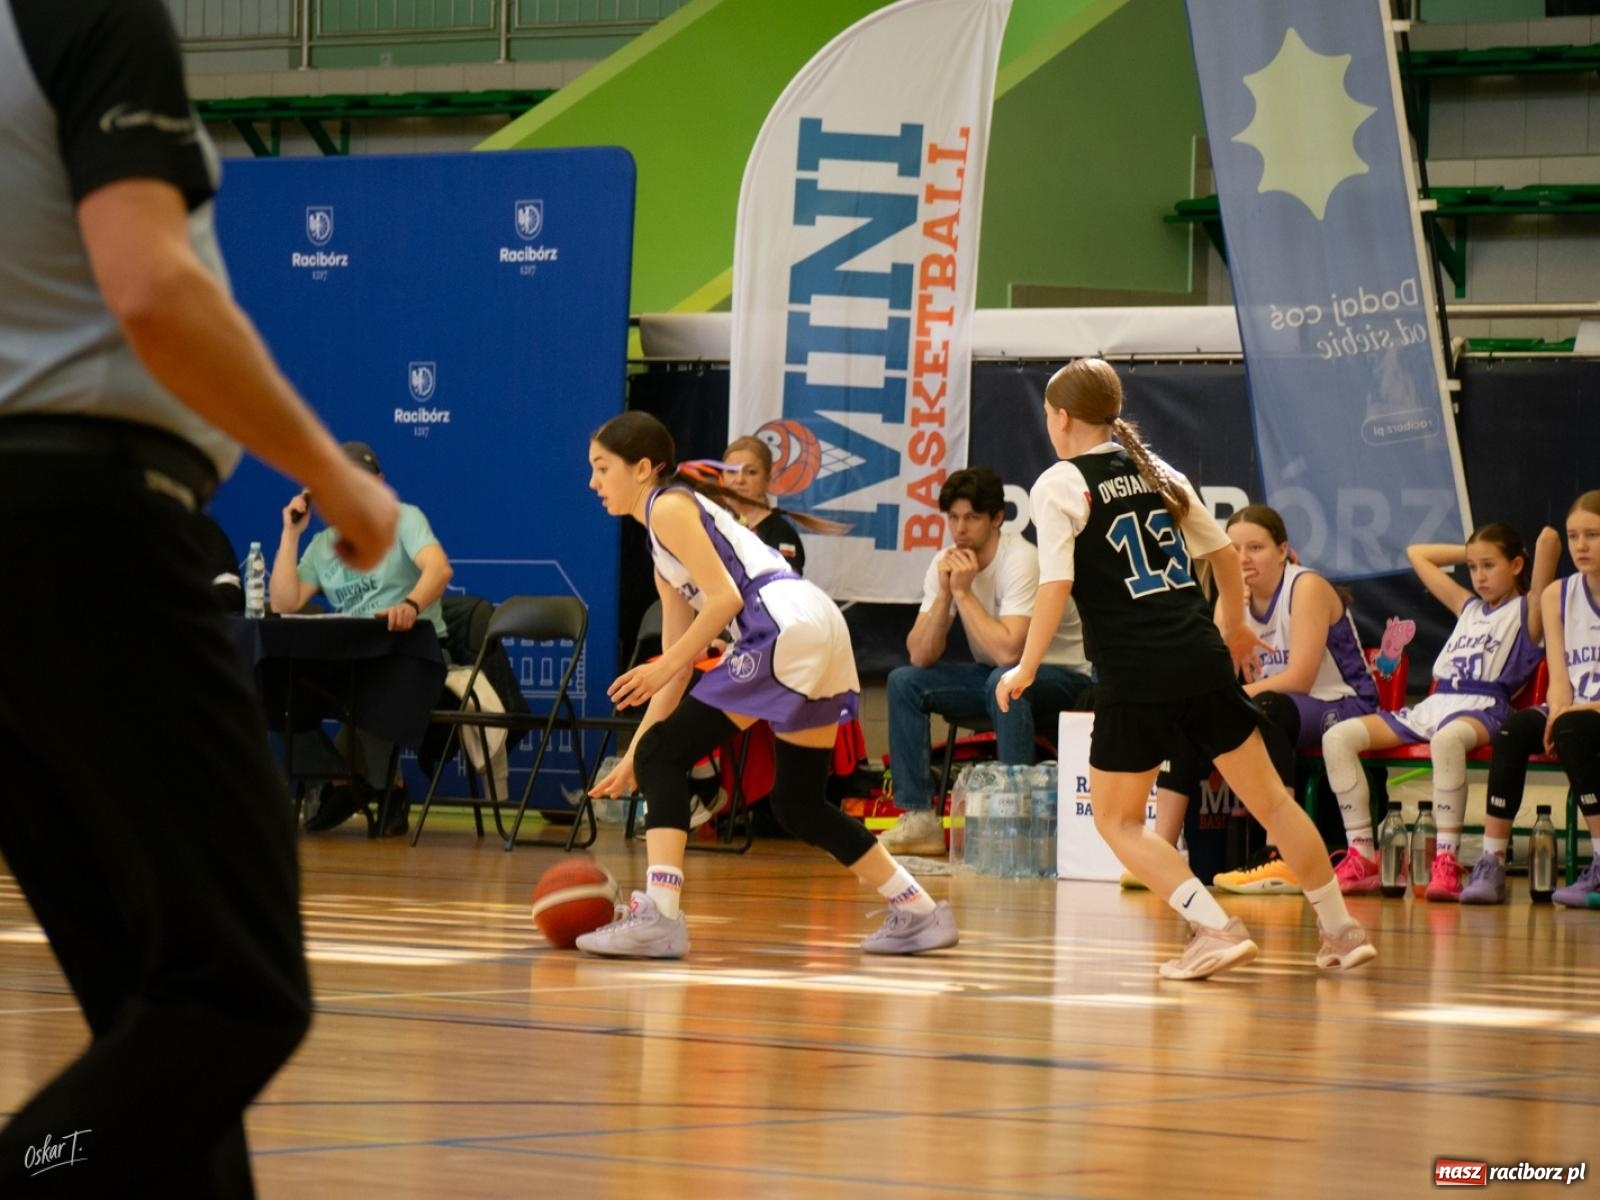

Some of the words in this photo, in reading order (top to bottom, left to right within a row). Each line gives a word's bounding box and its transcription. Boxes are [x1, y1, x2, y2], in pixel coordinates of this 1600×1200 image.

[291, 251, 349, 267] Racibórz
[499, 245, 558, 262] Racibórz
[777, 117, 924, 551] MINI
[903, 126, 970, 552] BASKETBALL
[394, 407, 450, 423] Racibórz
[1098, 474, 1158, 504] OWSIAN
[1105, 508, 1197, 600] 13
